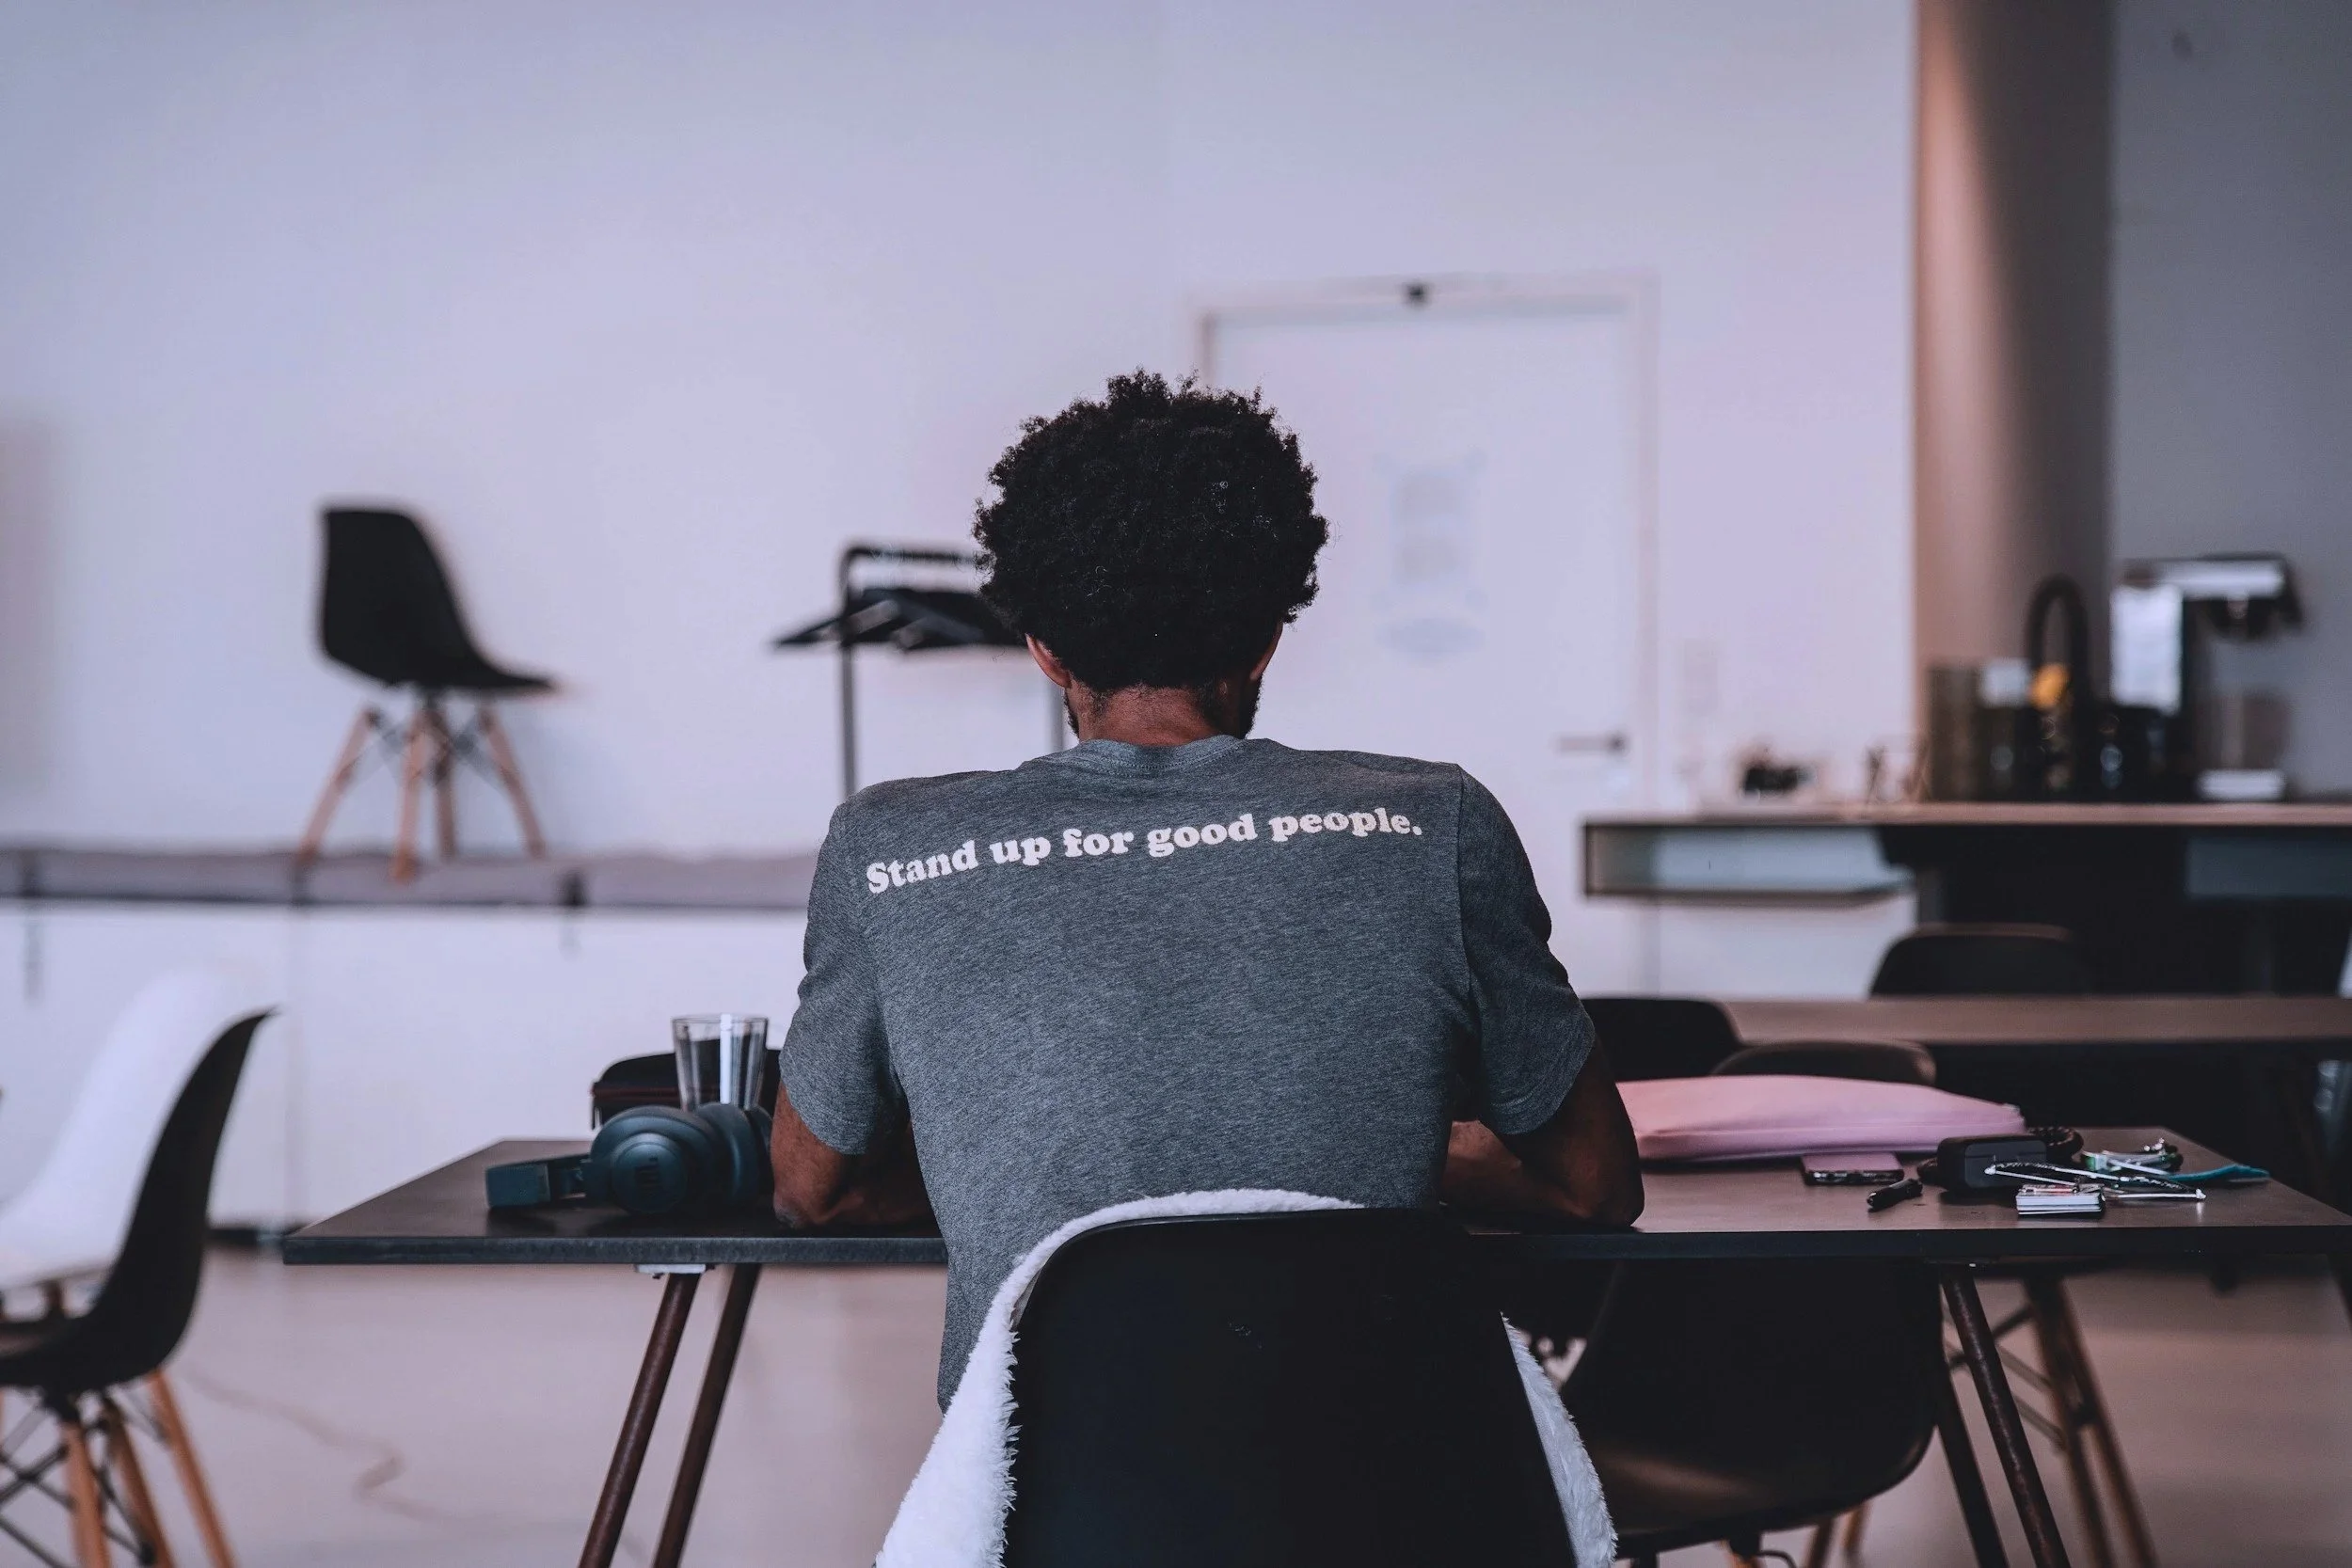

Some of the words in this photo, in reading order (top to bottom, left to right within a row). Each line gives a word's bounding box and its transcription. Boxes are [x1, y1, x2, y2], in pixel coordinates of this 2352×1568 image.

[866, 839, 979, 895] Stand
[989, 837, 1052, 866] up
[1062, 827, 1135, 858] for
[1147, 814, 1259, 858] good
[1268, 808, 1422, 843] people.
